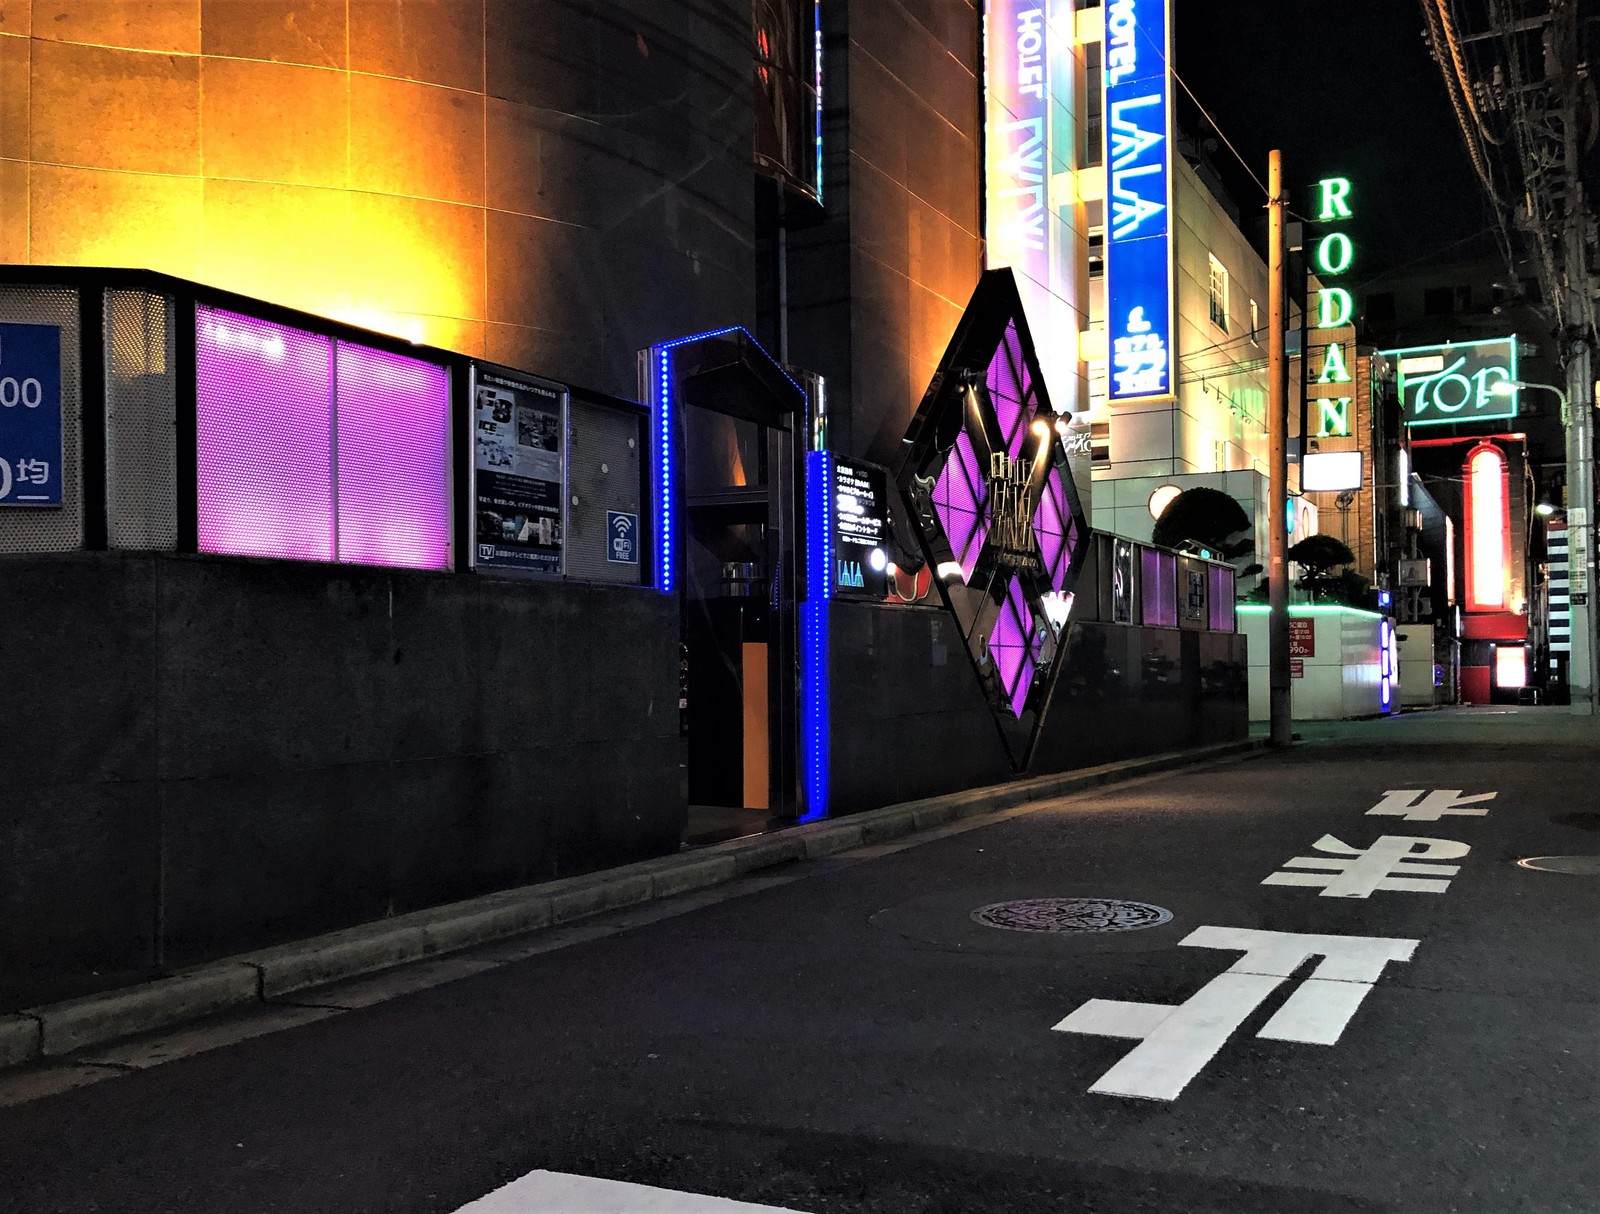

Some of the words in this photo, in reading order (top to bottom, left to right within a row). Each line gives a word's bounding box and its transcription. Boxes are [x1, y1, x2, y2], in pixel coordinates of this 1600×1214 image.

[1111, 93, 1166, 240] LALA
[1317, 177, 1353, 438] RODAN
[482, 546, 493, 556] TV
[615, 551, 630, 561] FREE
